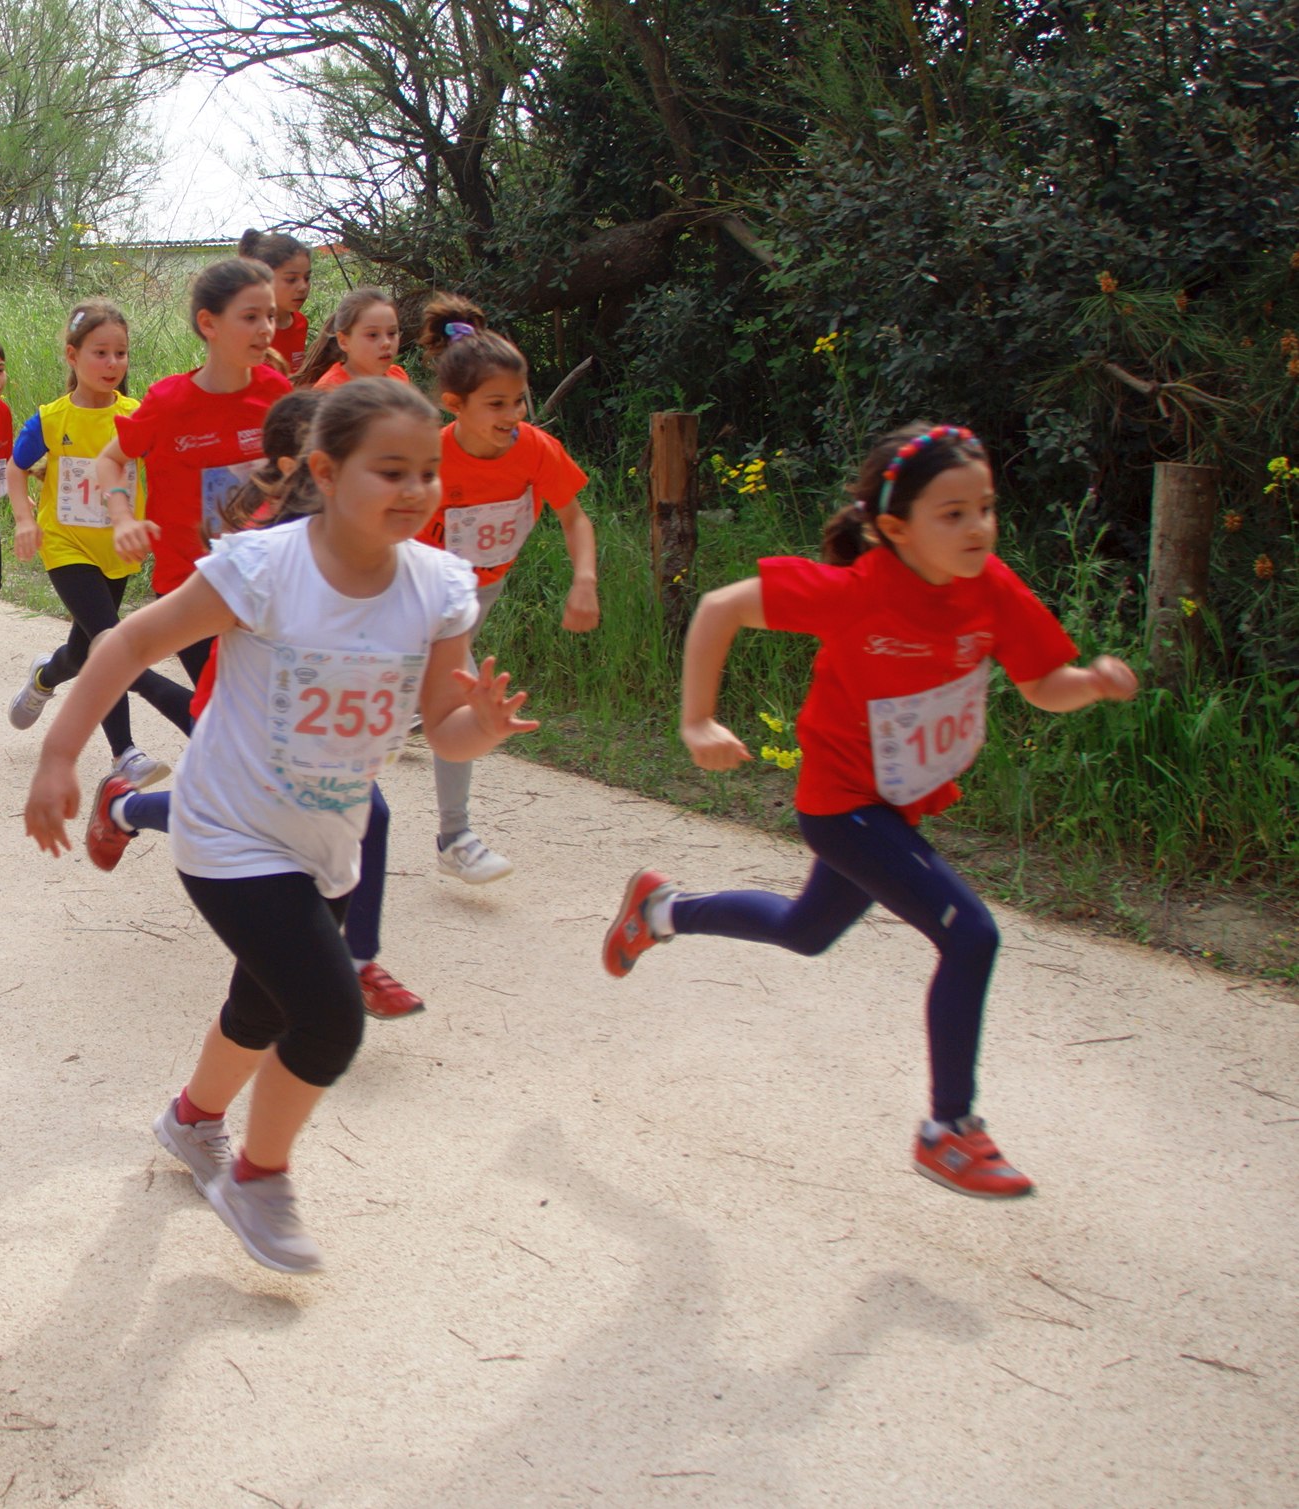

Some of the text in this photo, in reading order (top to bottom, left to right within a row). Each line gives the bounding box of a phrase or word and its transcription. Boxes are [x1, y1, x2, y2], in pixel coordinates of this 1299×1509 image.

[477, 520, 516, 551] 85
[293, 687, 395, 738] 253
[905, 702, 976, 767] 106
